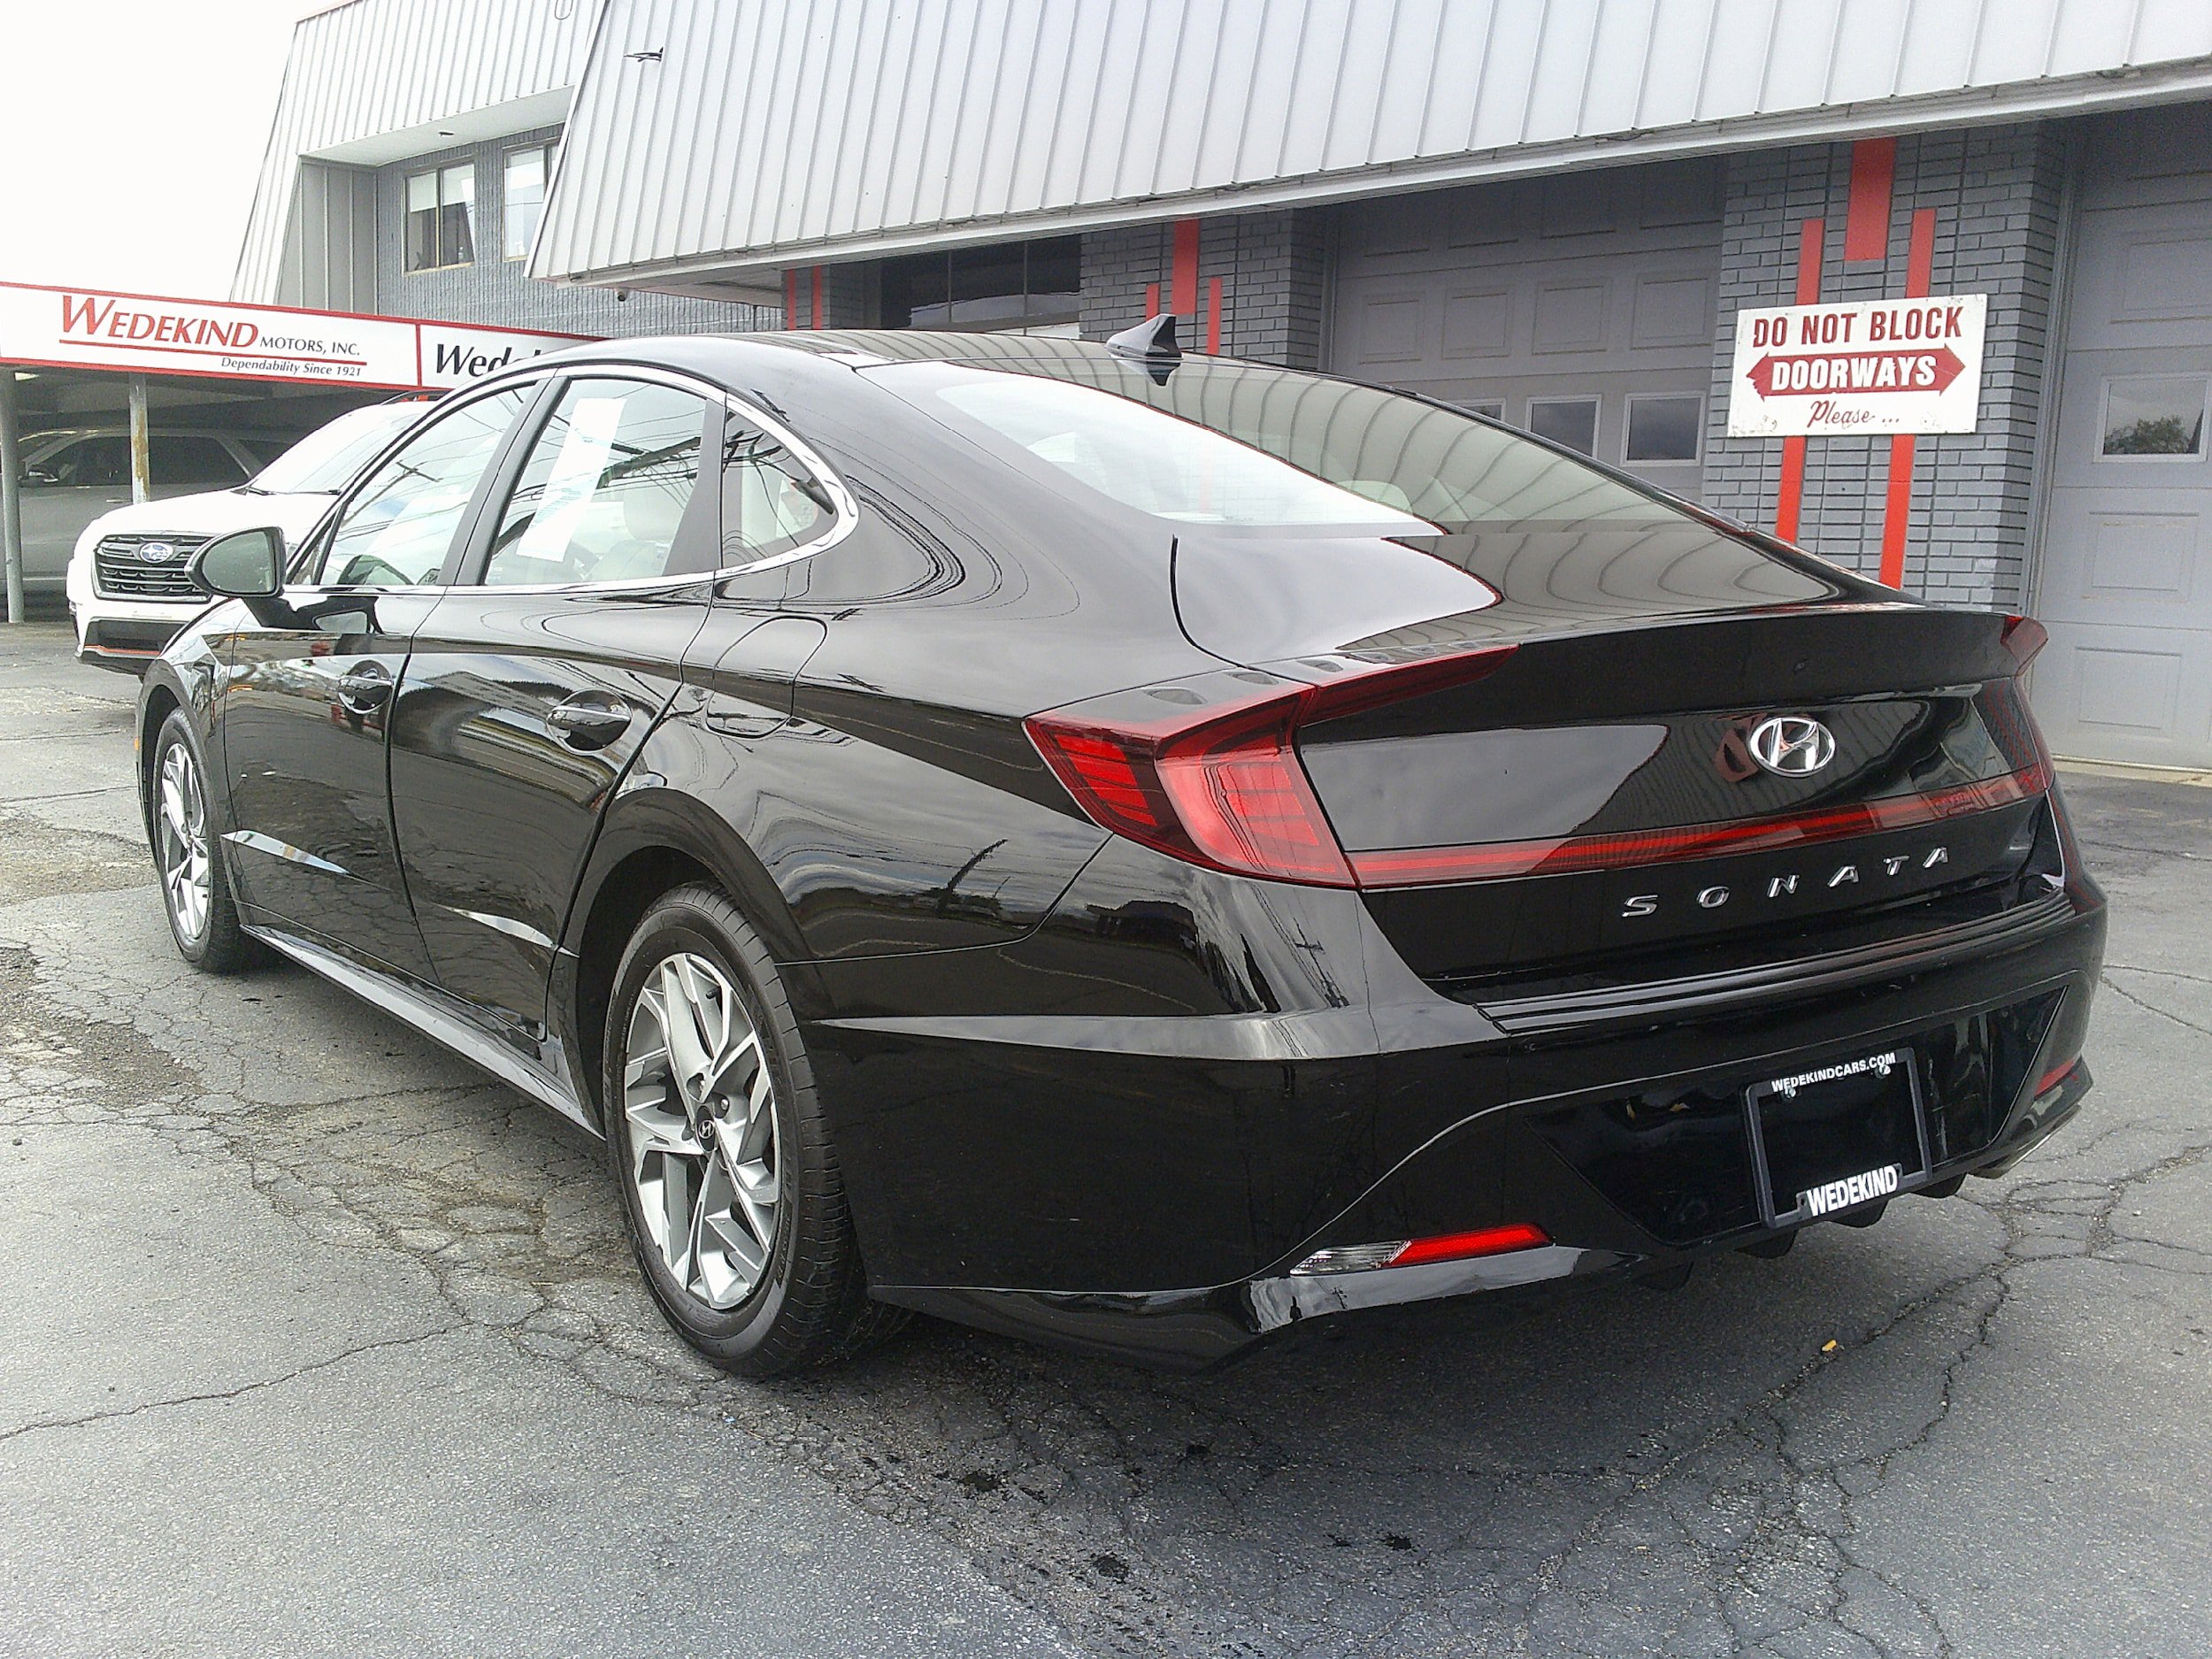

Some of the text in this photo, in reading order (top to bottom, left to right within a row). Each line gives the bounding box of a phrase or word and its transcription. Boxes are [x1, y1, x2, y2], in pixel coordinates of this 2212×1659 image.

[62, 295, 360, 356] WEDEKIND MOTORS, INC.
[1753, 306, 1963, 348] DO NOT BLOCK
[221, 357, 361, 377] Dependability Since 1921
[1770, 355, 1938, 391] DOORWAYS
[1806, 400, 1875, 428] Please
[1621, 847, 1948, 918] SONATA
[1771, 1052, 1896, 1094] WEDEKINDCARS.COM
[1807, 1164, 1899, 1217] WEDEKIND
